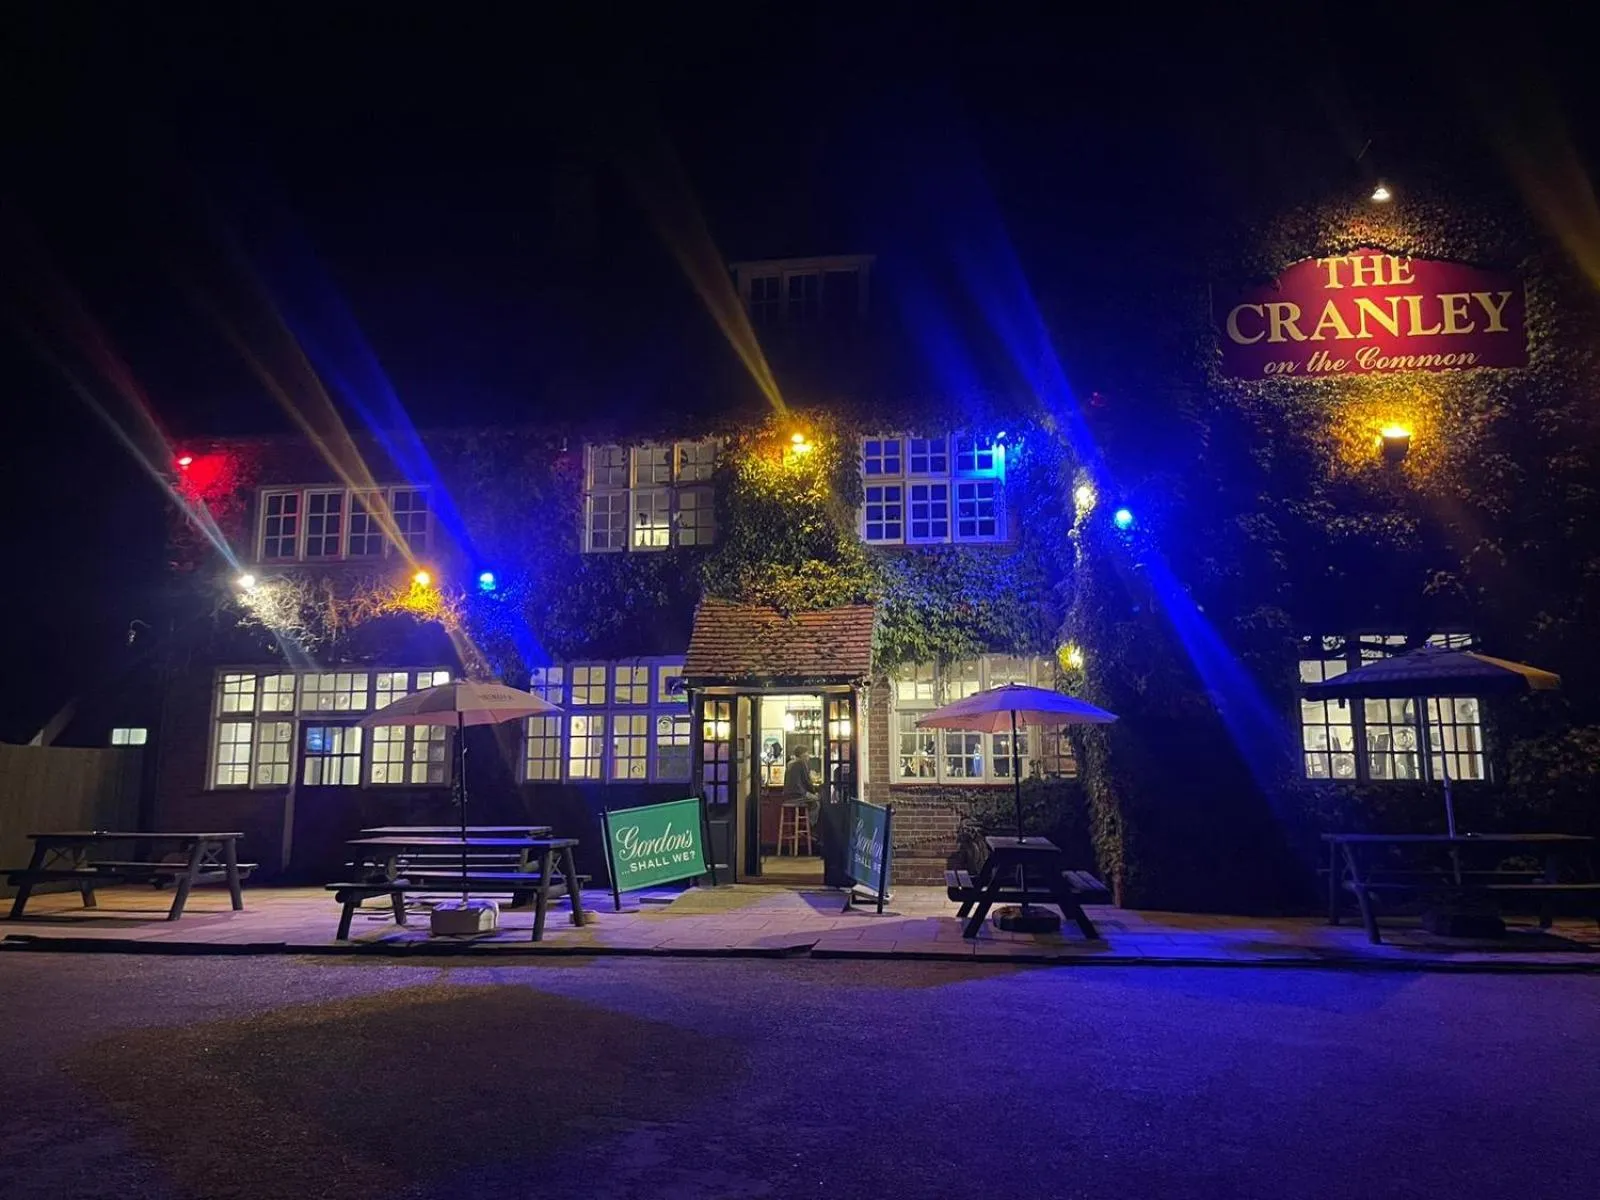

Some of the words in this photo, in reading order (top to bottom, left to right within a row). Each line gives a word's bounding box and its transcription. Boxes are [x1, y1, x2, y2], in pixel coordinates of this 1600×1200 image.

[1316, 254, 1416, 289] THE
[1226, 291, 1513, 345] CRANLEY
[1263, 361, 1300, 375] on
[1306, 350, 1352, 373] the
[1355, 346, 1481, 370] Common
[615, 822, 693, 861] Gordon's
[672, 850, 696, 863] WE?
[854, 818, 884, 860] Gordon
